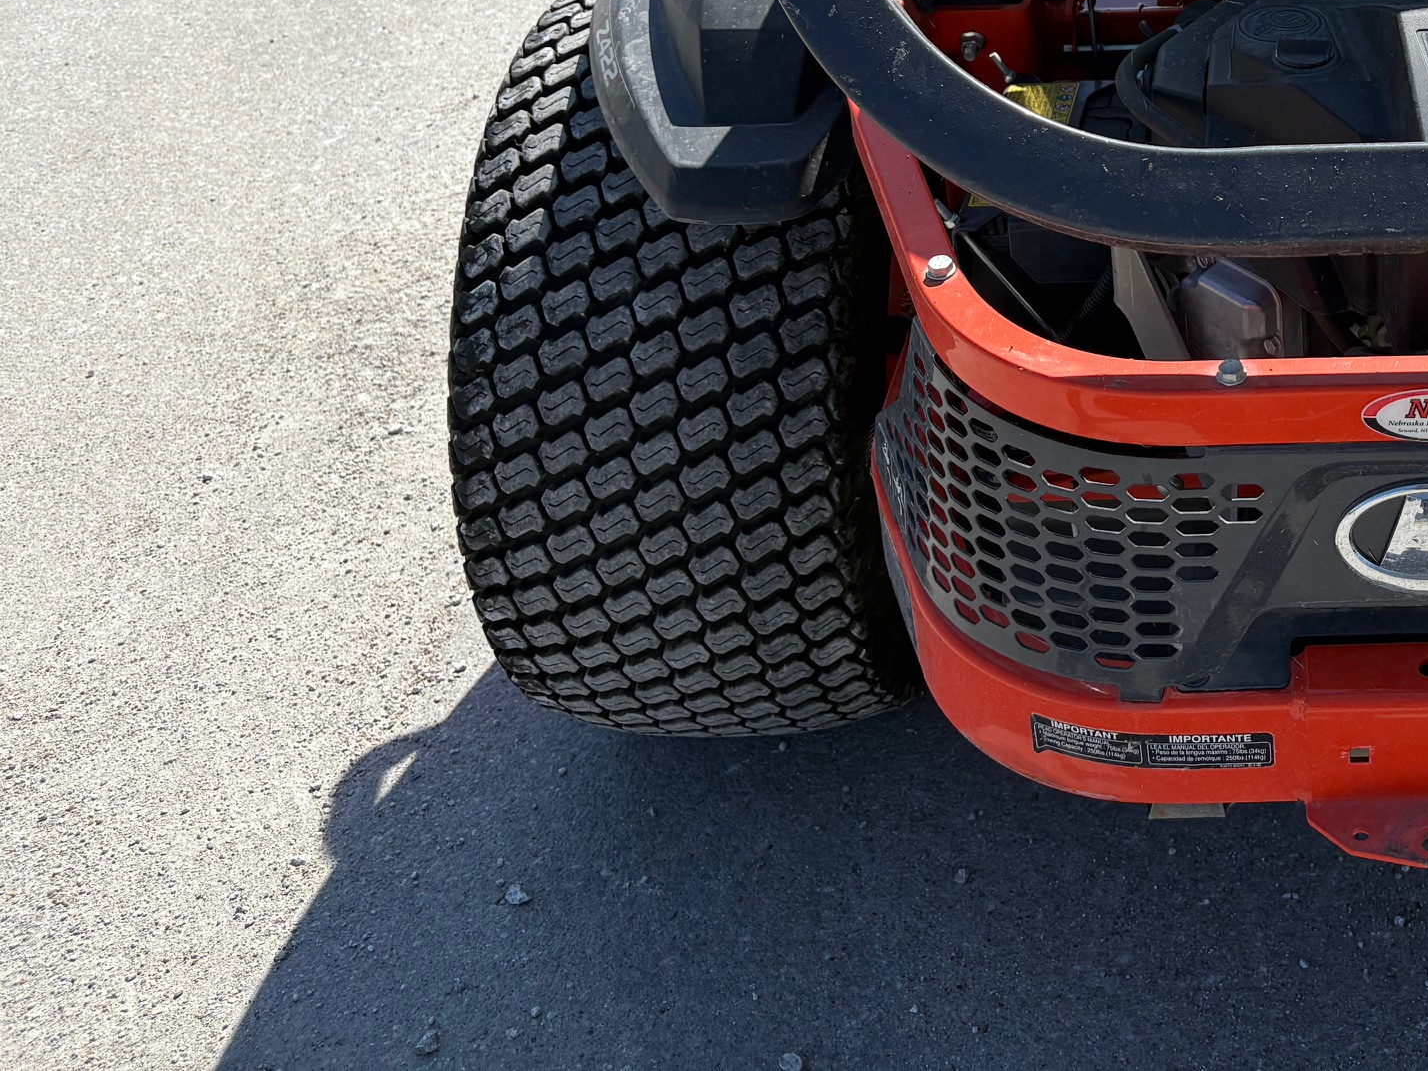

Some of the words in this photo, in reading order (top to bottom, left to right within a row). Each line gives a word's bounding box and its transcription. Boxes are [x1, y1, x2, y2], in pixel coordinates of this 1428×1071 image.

[596, 20, 618, 87] Z422
[1050, 720, 1118, 740] IMPORTANT
[1168, 734, 1252, 743] IMPORTANTE
